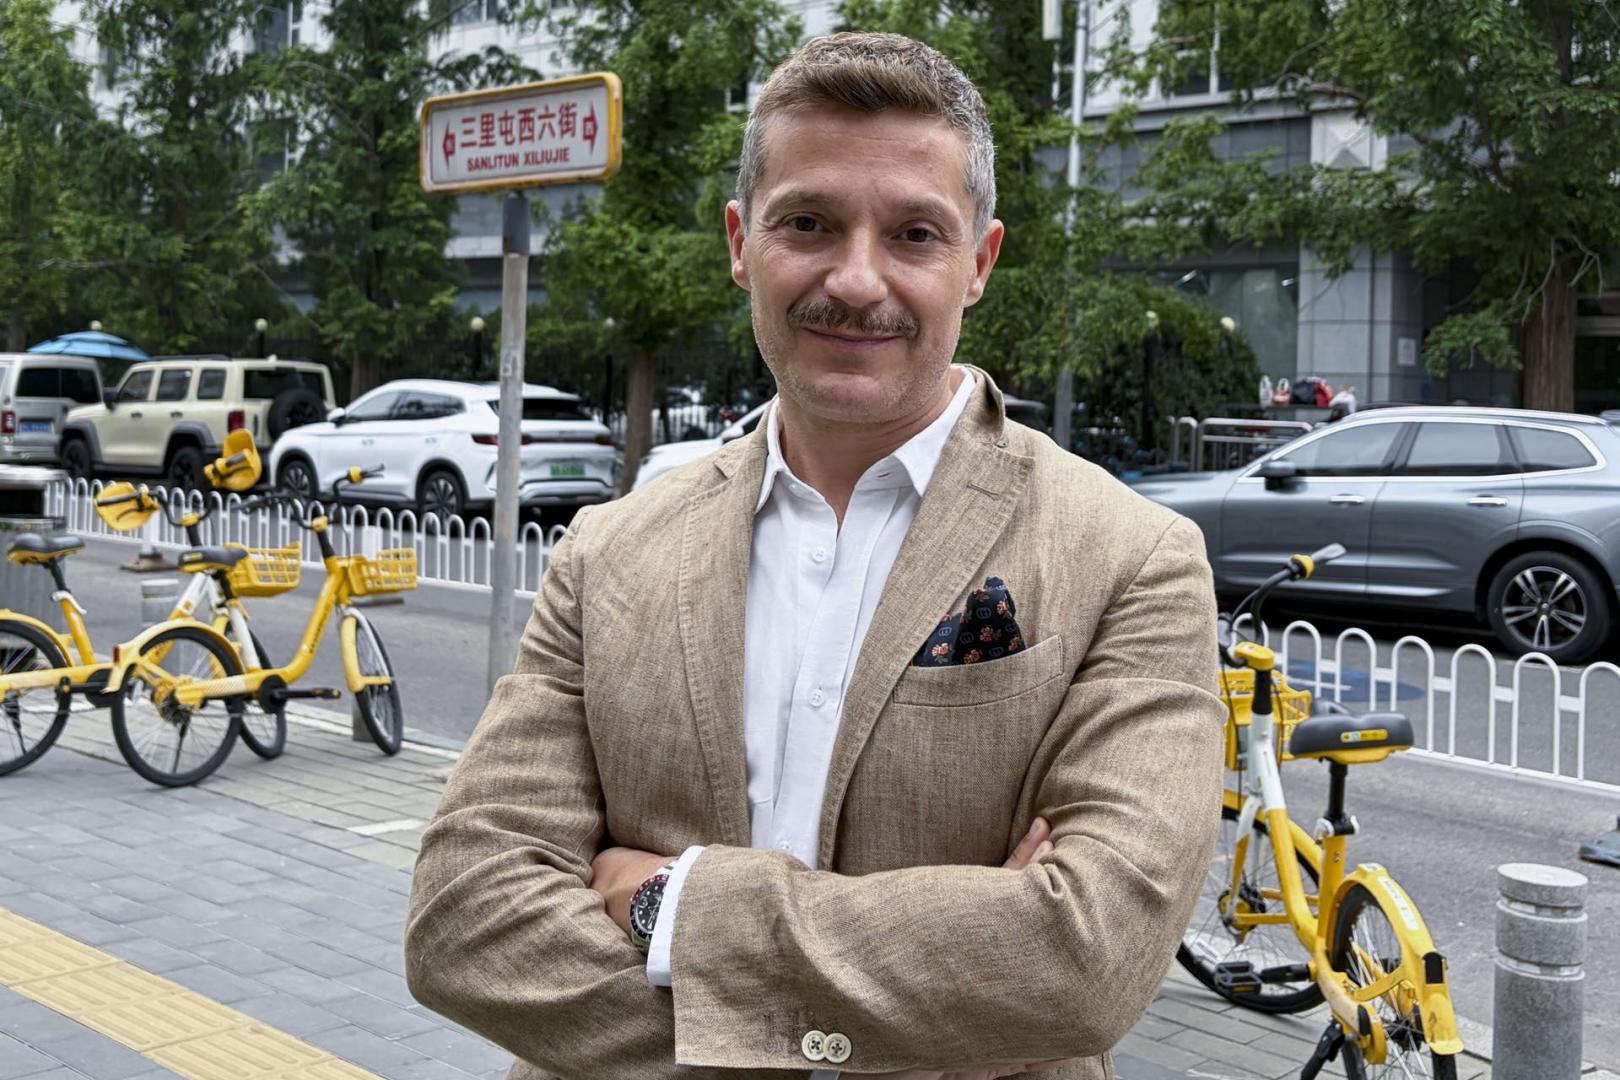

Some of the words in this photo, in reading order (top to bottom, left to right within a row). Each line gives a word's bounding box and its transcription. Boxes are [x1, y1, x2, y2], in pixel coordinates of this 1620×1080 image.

[461, 103, 577, 148] 三里屯西六街
[467, 153, 519, 172] SANLITUN
[524, 147, 570, 166] XILIUJIE
